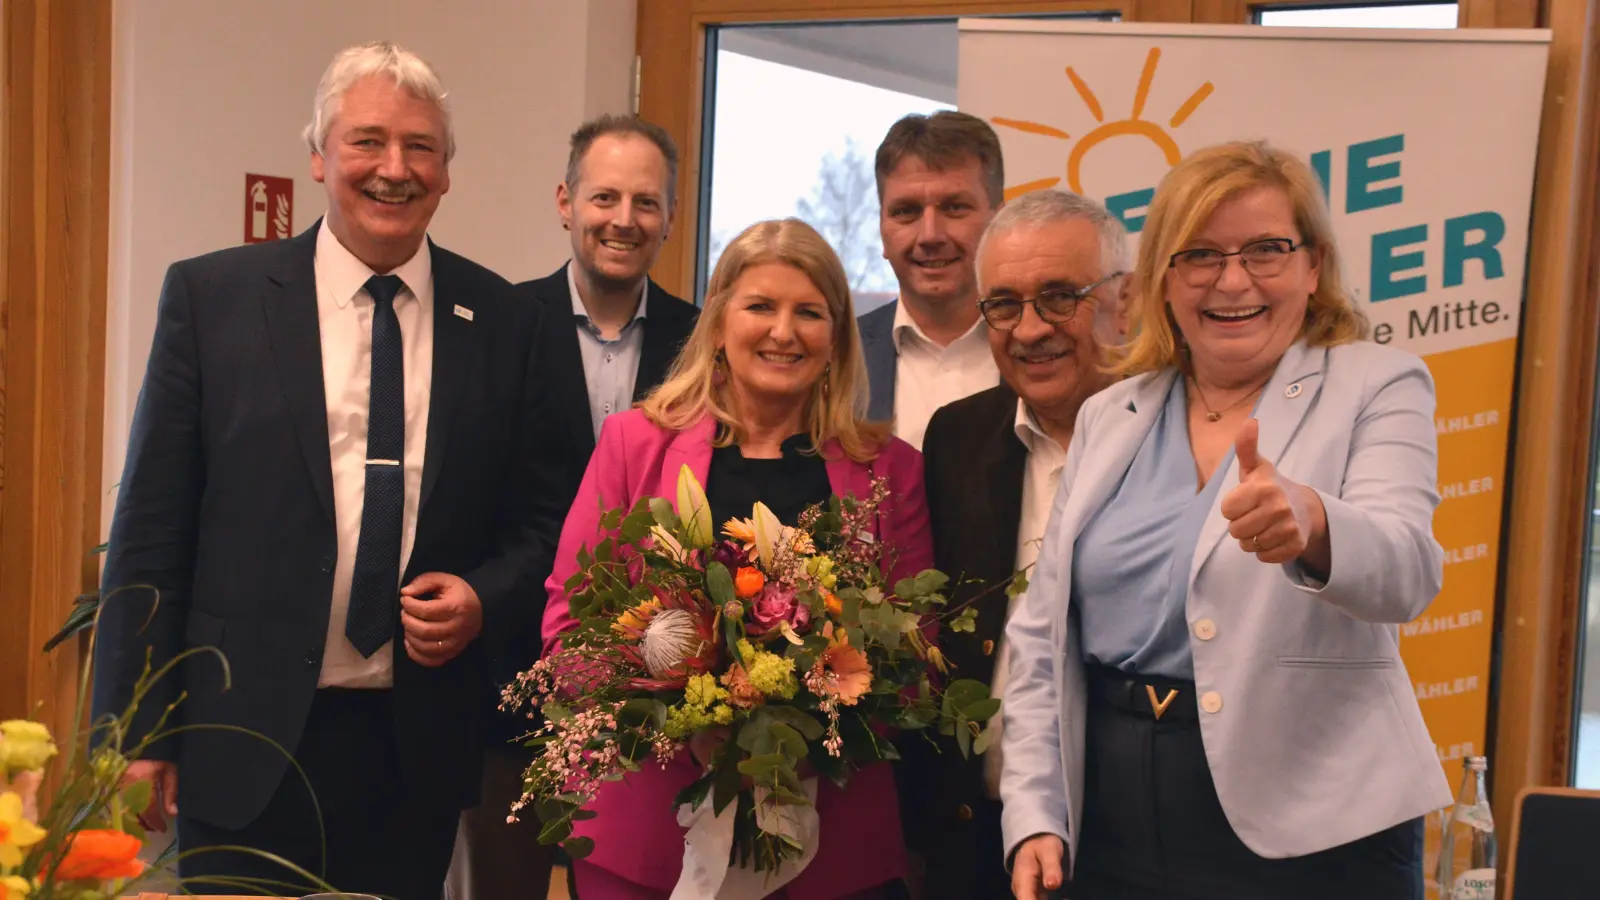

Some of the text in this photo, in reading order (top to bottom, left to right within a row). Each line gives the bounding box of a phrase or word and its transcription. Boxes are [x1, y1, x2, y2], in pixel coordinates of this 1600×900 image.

[1408, 299, 1510, 340] Mitte.
[1436, 409, 1499, 435] ÄHLER
[1403, 609, 1484, 637] WÄHLER
[1415, 675, 1478, 700] ÄHLER
